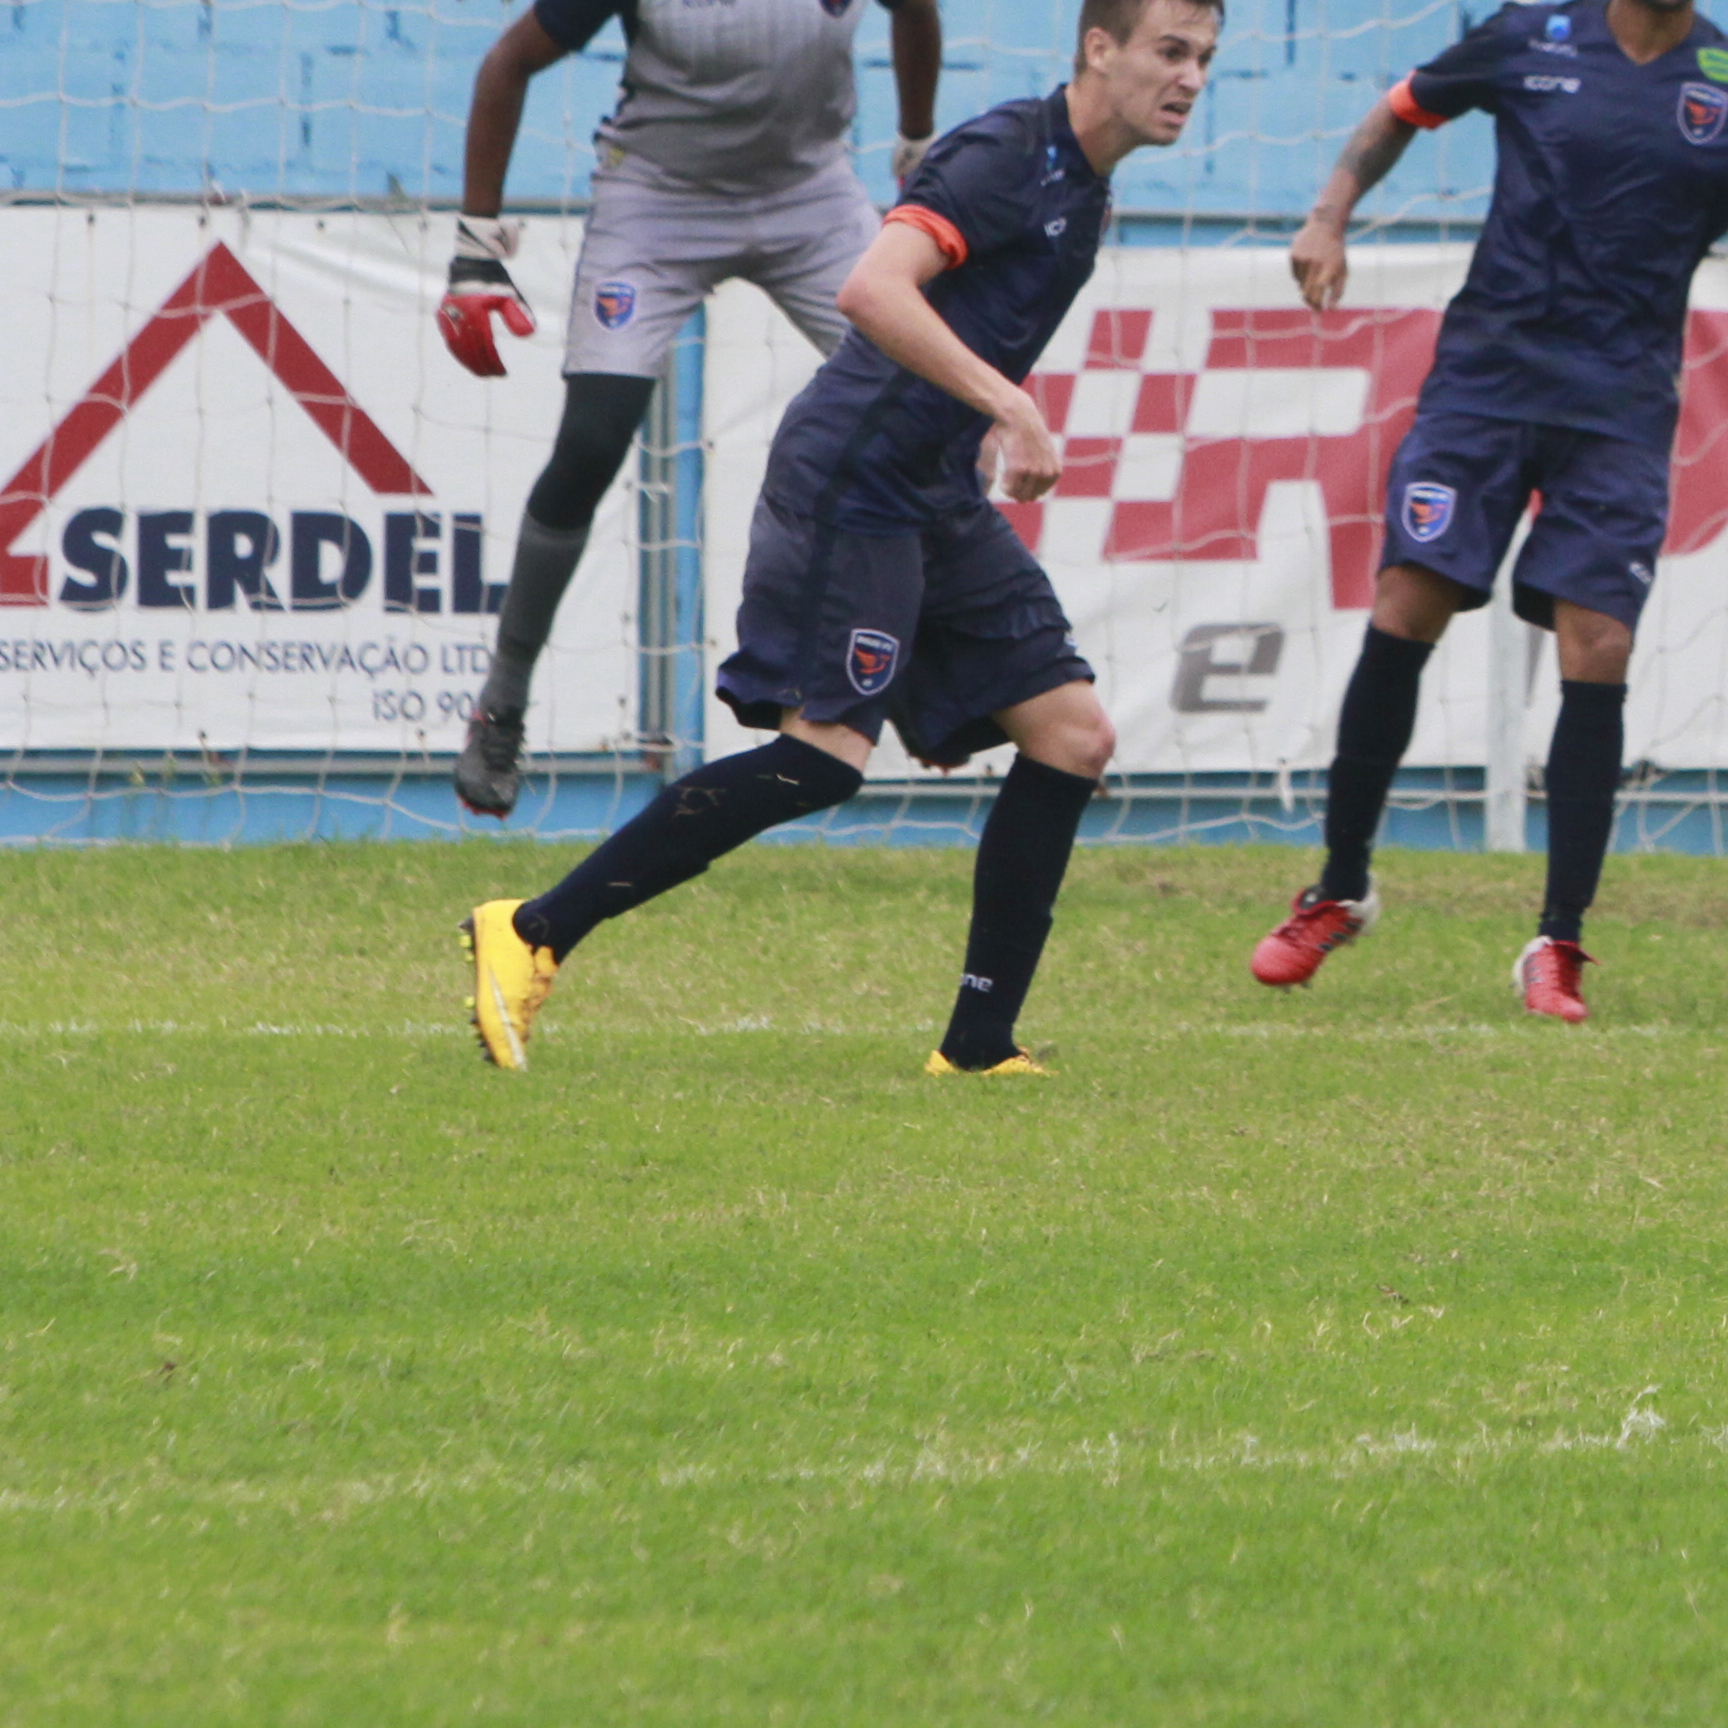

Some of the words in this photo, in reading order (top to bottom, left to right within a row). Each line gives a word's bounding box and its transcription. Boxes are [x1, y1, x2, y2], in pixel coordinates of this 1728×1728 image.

[59, 507, 510, 613] SERDEL
[0, 639, 146, 679] SERVIÇOS
[160, 640, 175, 672] E
[187, 634, 430, 680] CONSERVAÇÃO
[441, 643, 492, 674] LTD
[373, 690, 426, 721] ISO
[437, 690, 477, 723] 90
